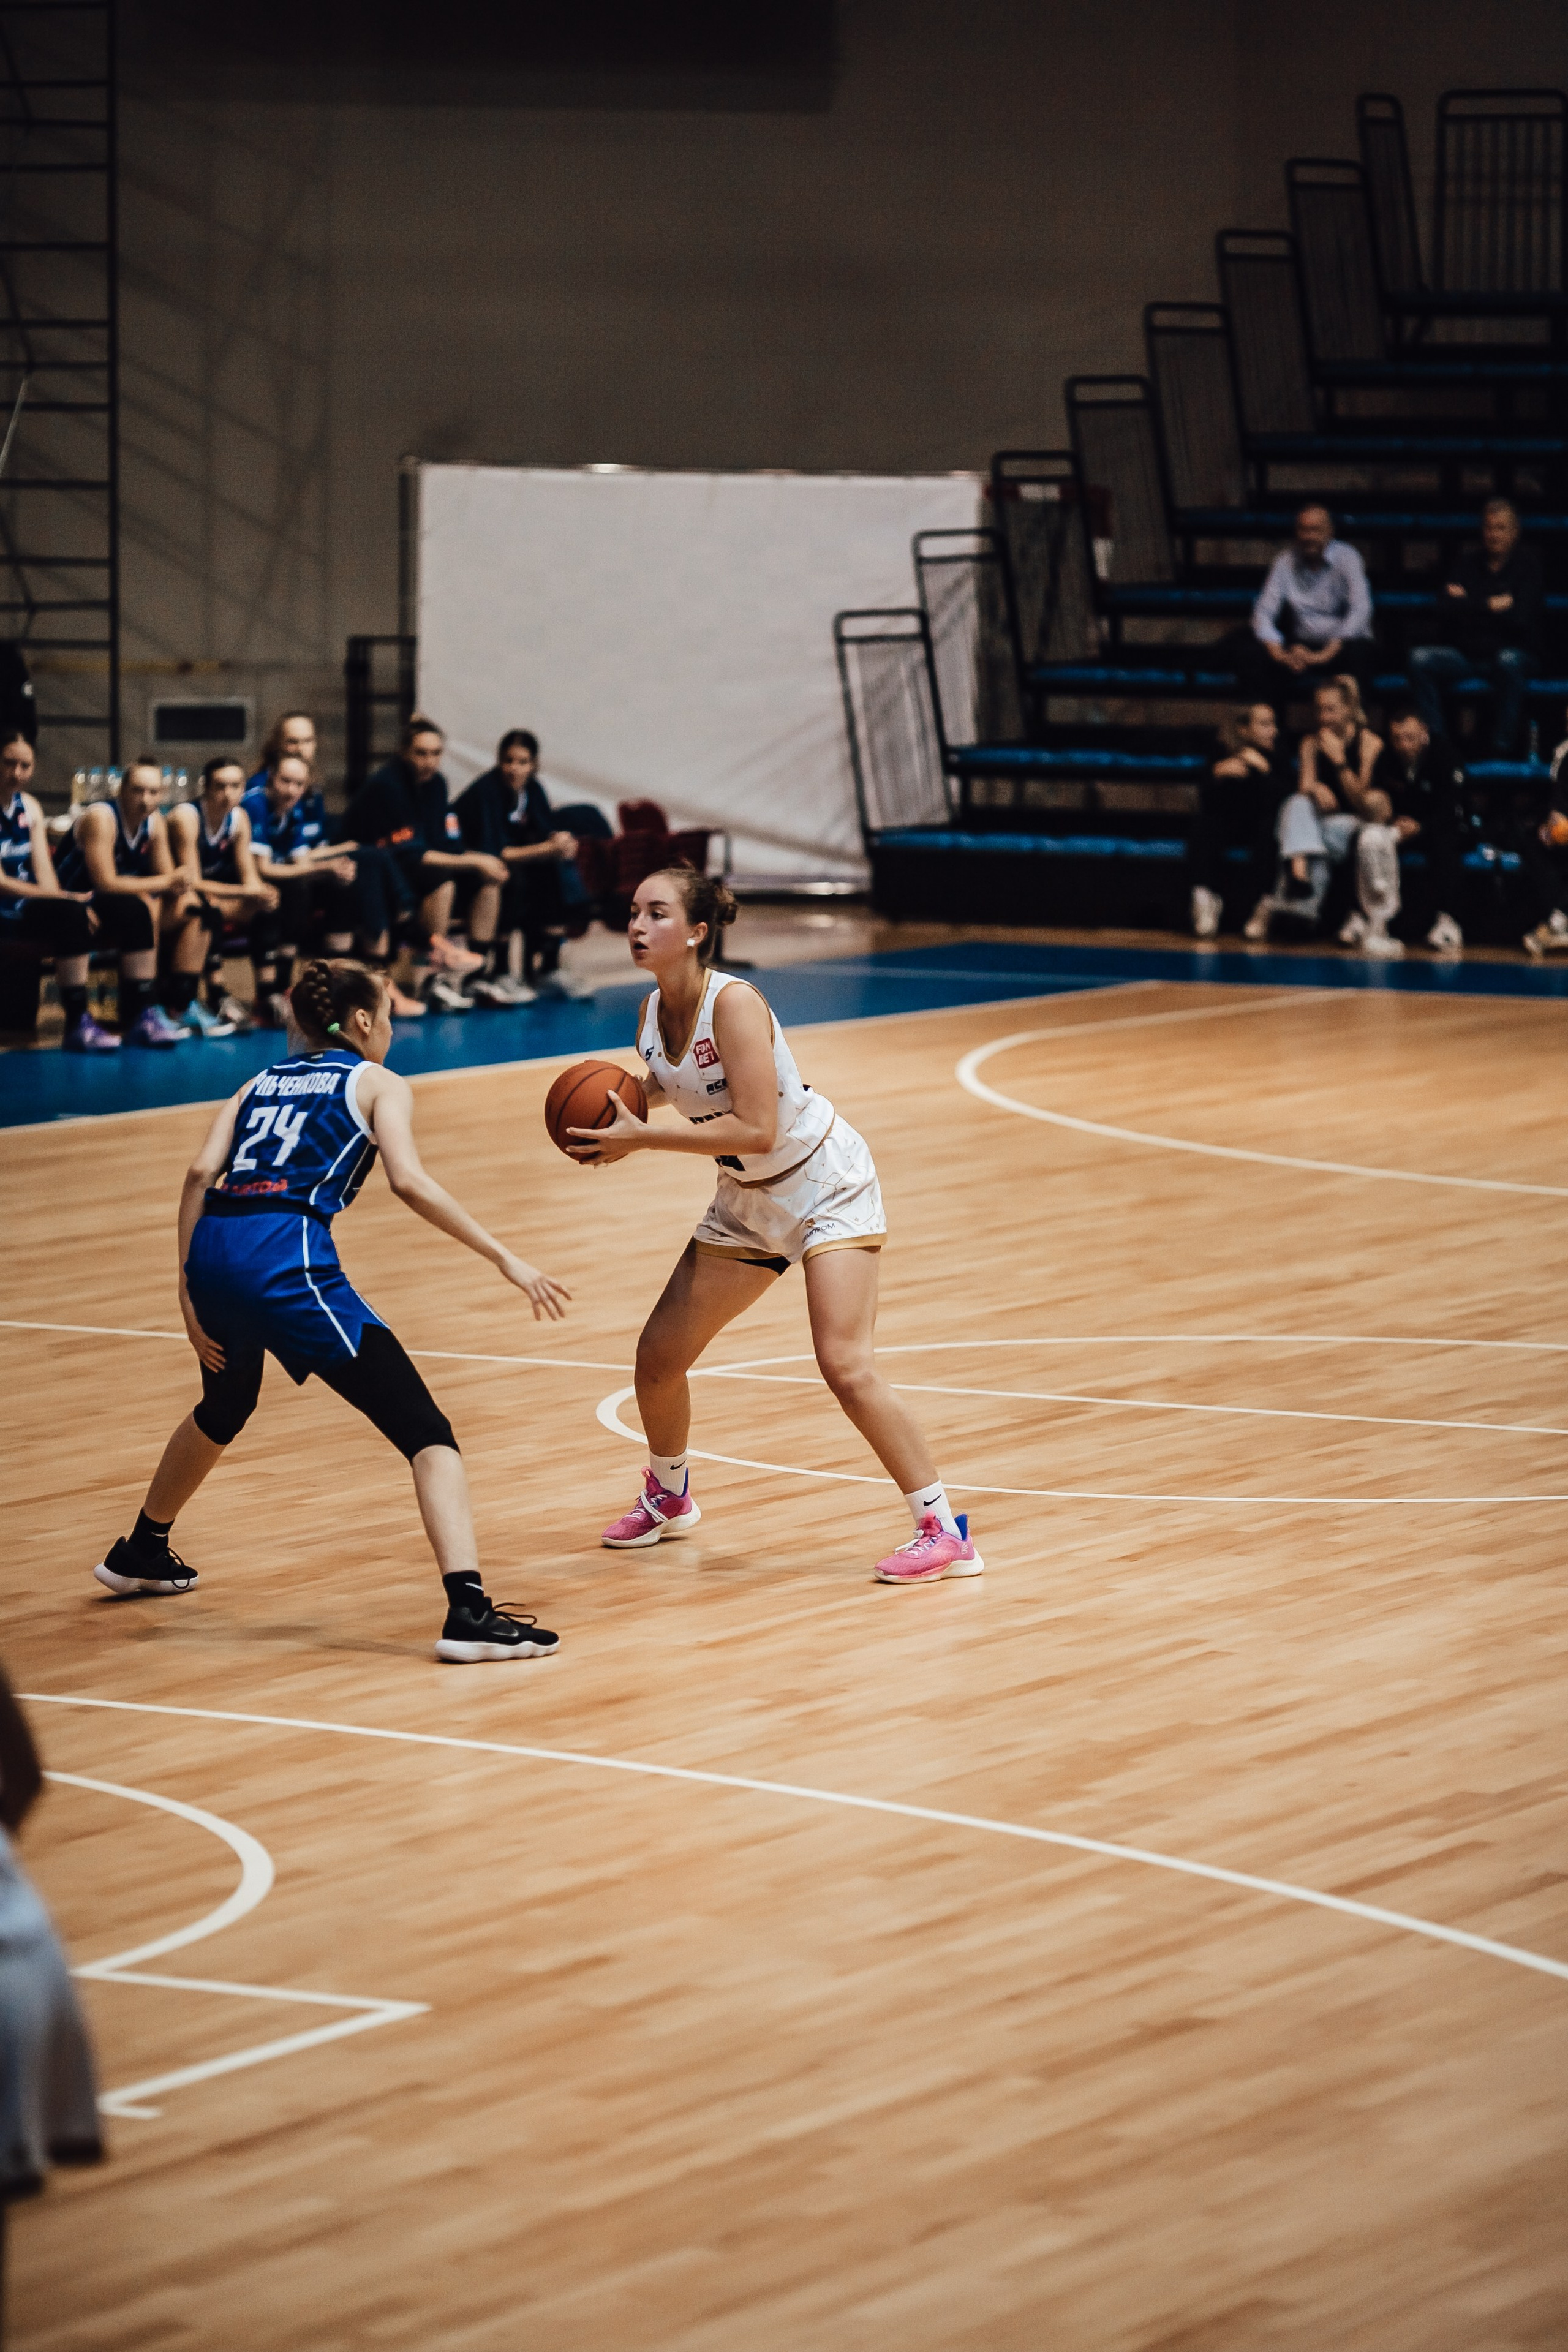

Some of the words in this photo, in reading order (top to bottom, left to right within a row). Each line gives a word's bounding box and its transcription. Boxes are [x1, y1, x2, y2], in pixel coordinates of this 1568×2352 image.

[695, 1041, 711, 1055] FON
[698, 1050, 715, 1065] BET
[232, 1104, 308, 1172] 24
